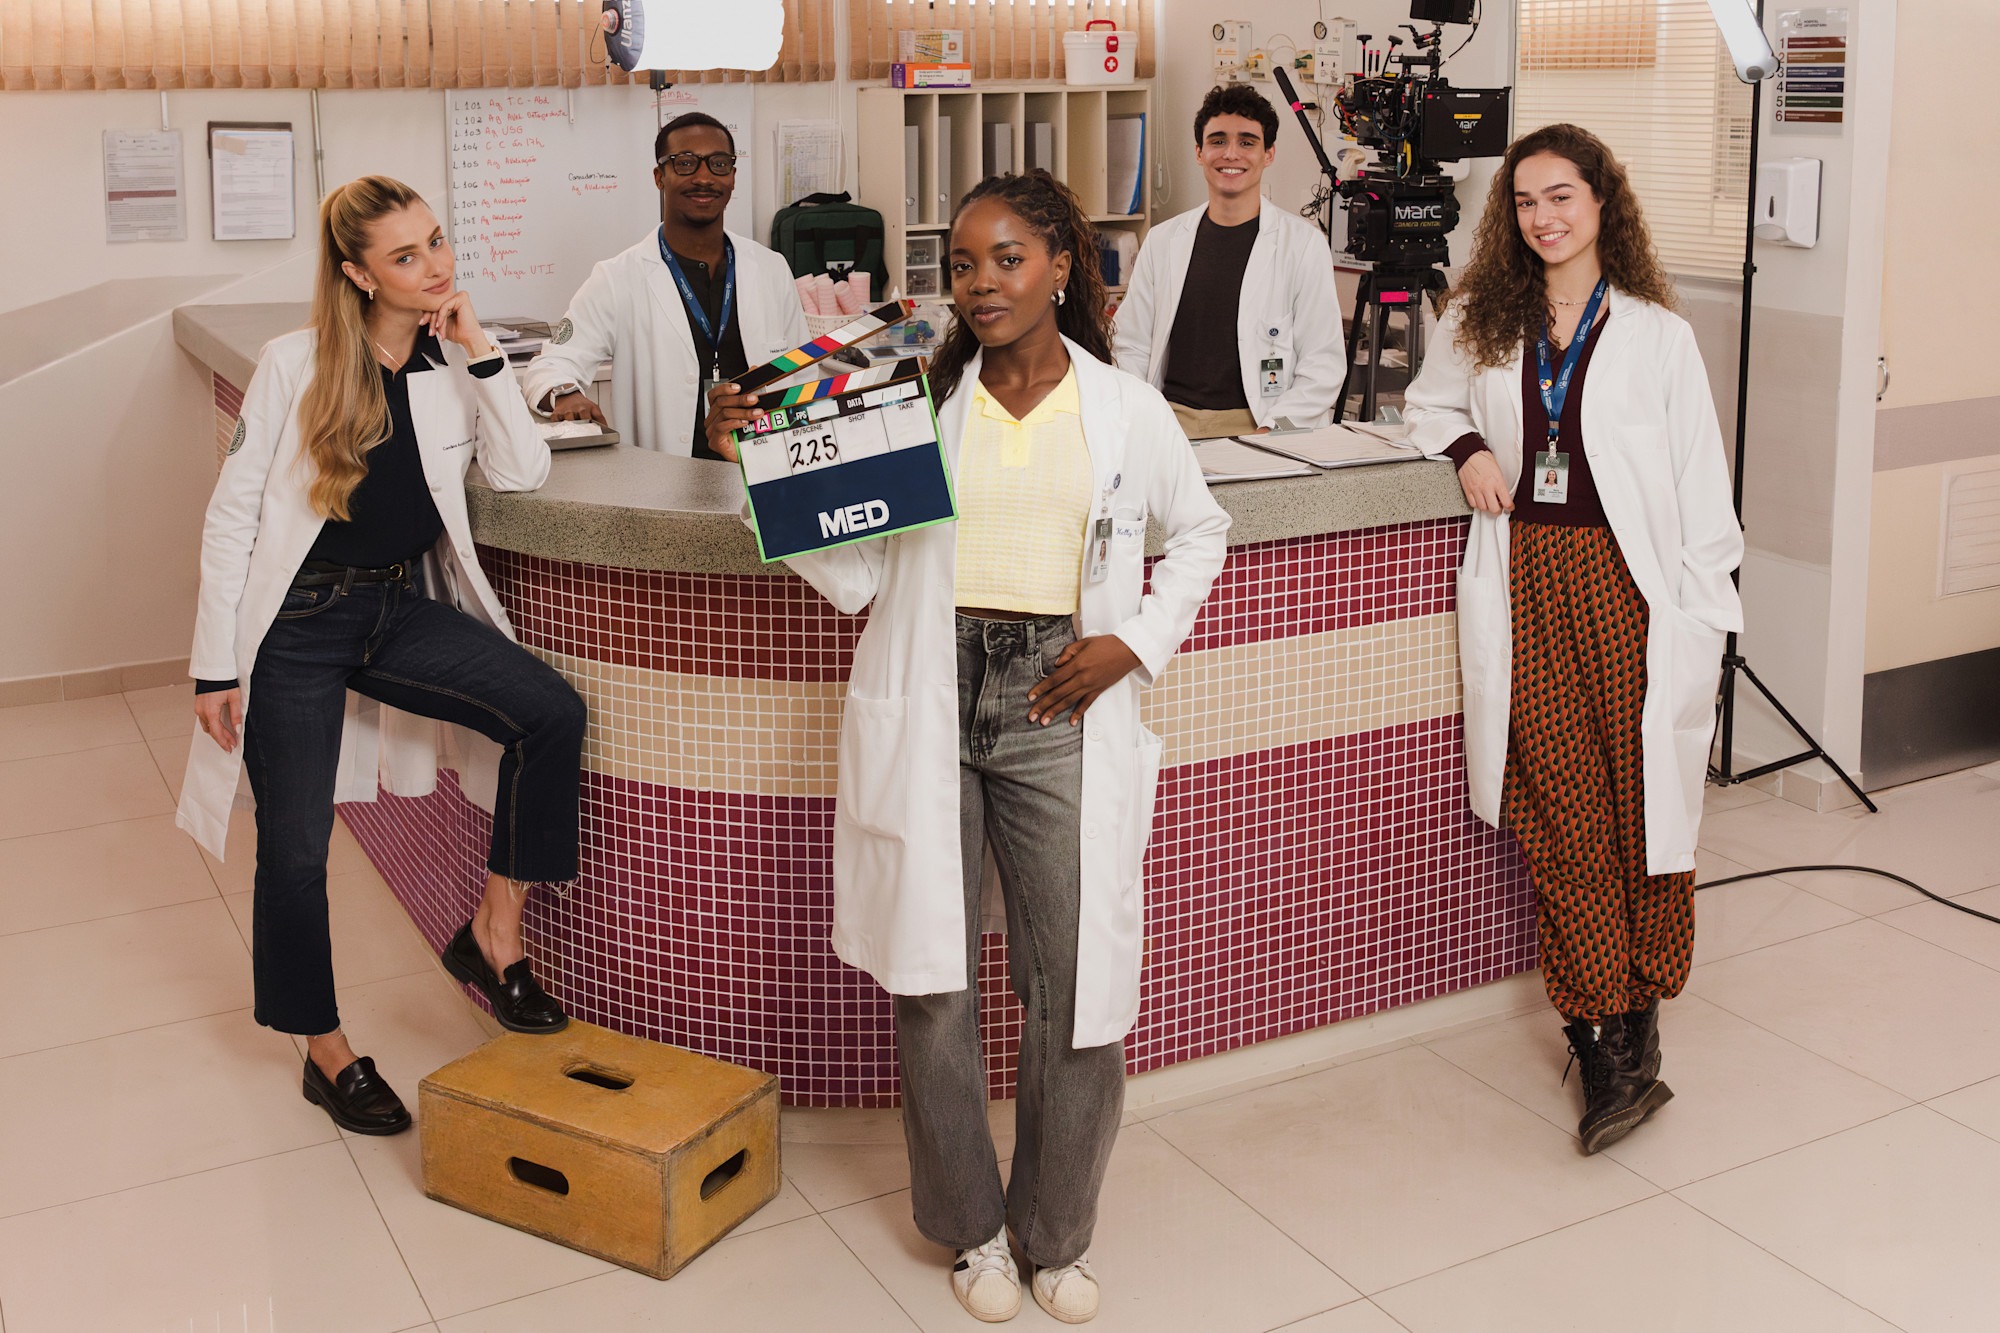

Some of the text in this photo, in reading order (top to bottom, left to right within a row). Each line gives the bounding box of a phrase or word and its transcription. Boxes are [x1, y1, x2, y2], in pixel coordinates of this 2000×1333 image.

[620, 0, 632, 48] Ulanz
[1780, 38, 1784, 49] 1
[1779, 52, 1785, 64] 2
[1778, 66, 1785, 78] 3
[1776, 82, 1784, 92] 4
[1776, 95, 1783, 107] 5
[1775, 110, 1783, 122] 6
[464, 129, 481, 137] 103
[847, 397, 863, 408] DATA
[898, 401, 914, 411] TAKE
[758, 417, 769, 430] A
[773, 413, 784, 427] B
[795, 410, 807, 421] FPS
[848, 413, 866, 423] SHOT
[792, 423, 823, 437] EP/SCENE
[752, 437, 769, 446] ROLL
[817, 498, 890, 540] MED
